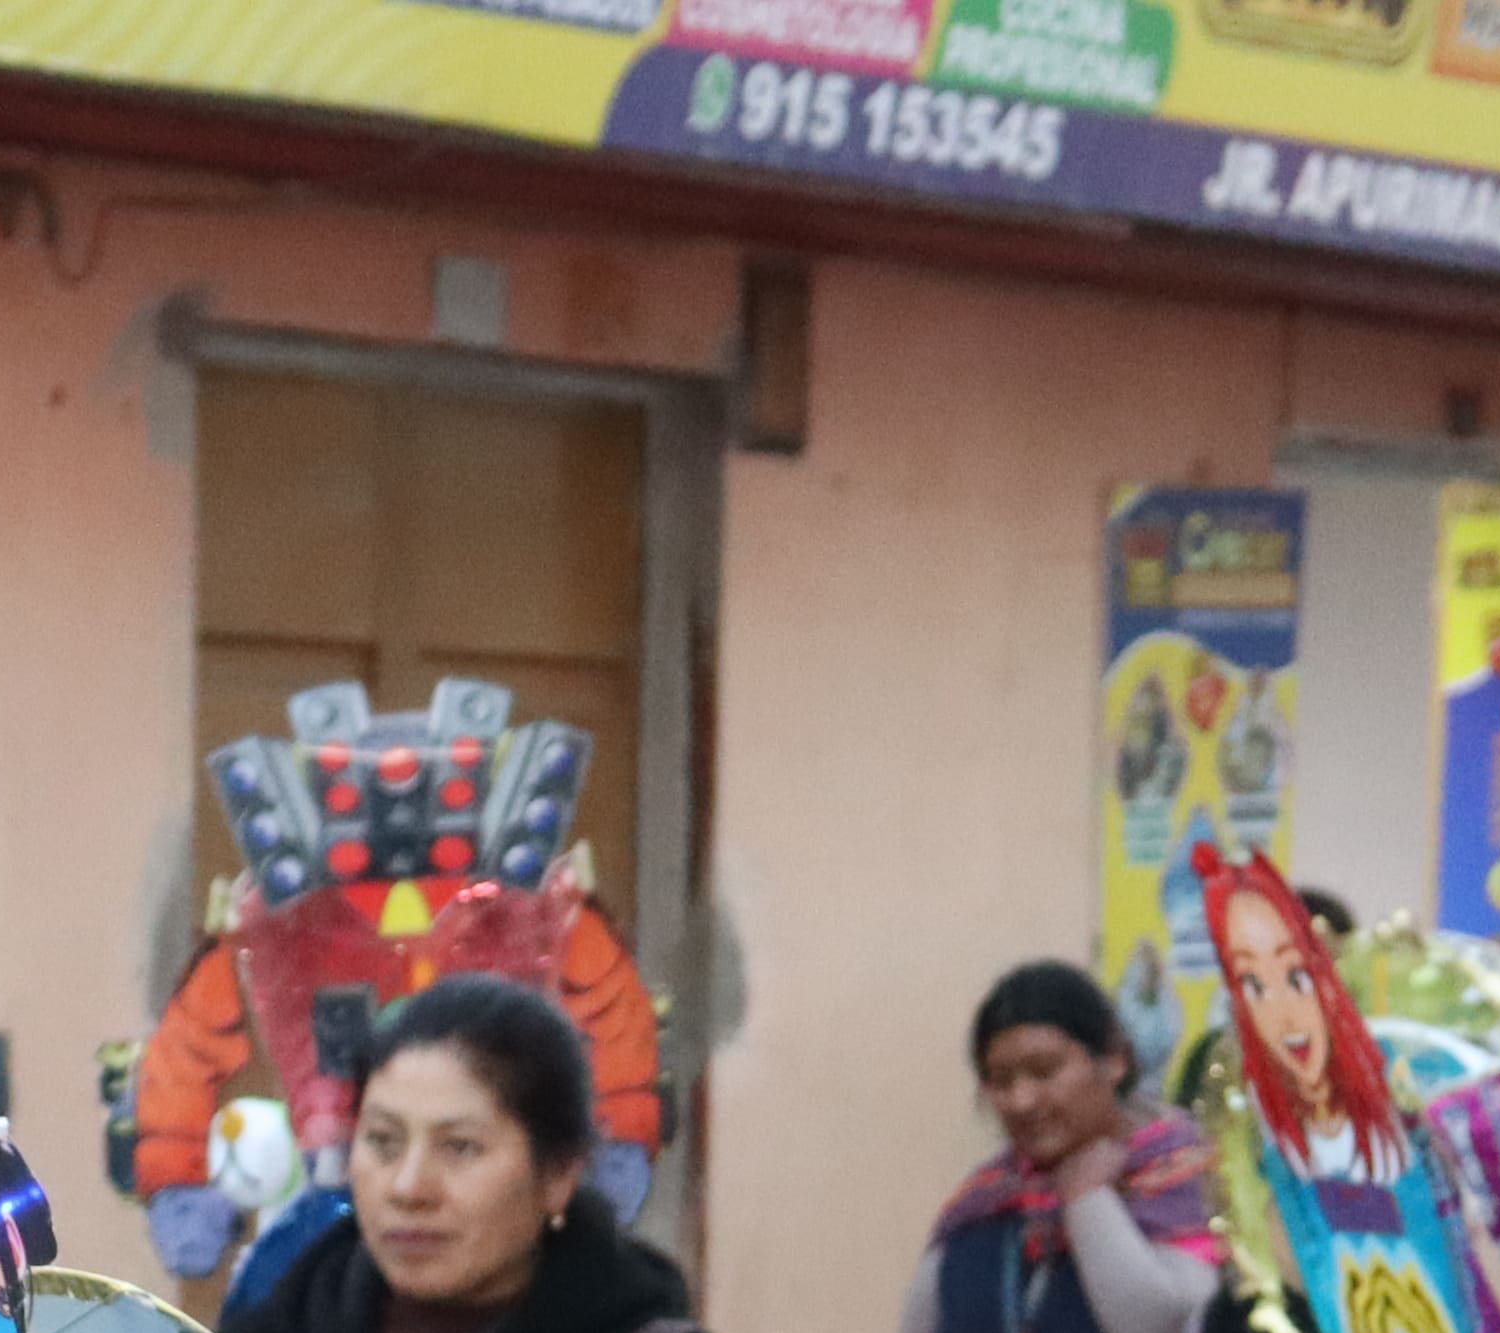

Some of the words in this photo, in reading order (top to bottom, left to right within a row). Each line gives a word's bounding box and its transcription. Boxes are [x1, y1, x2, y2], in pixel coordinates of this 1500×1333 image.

[740, 63, 853, 148] 915
[863, 81, 1067, 181] 153545
[1203, 138, 1281, 215] JR.
